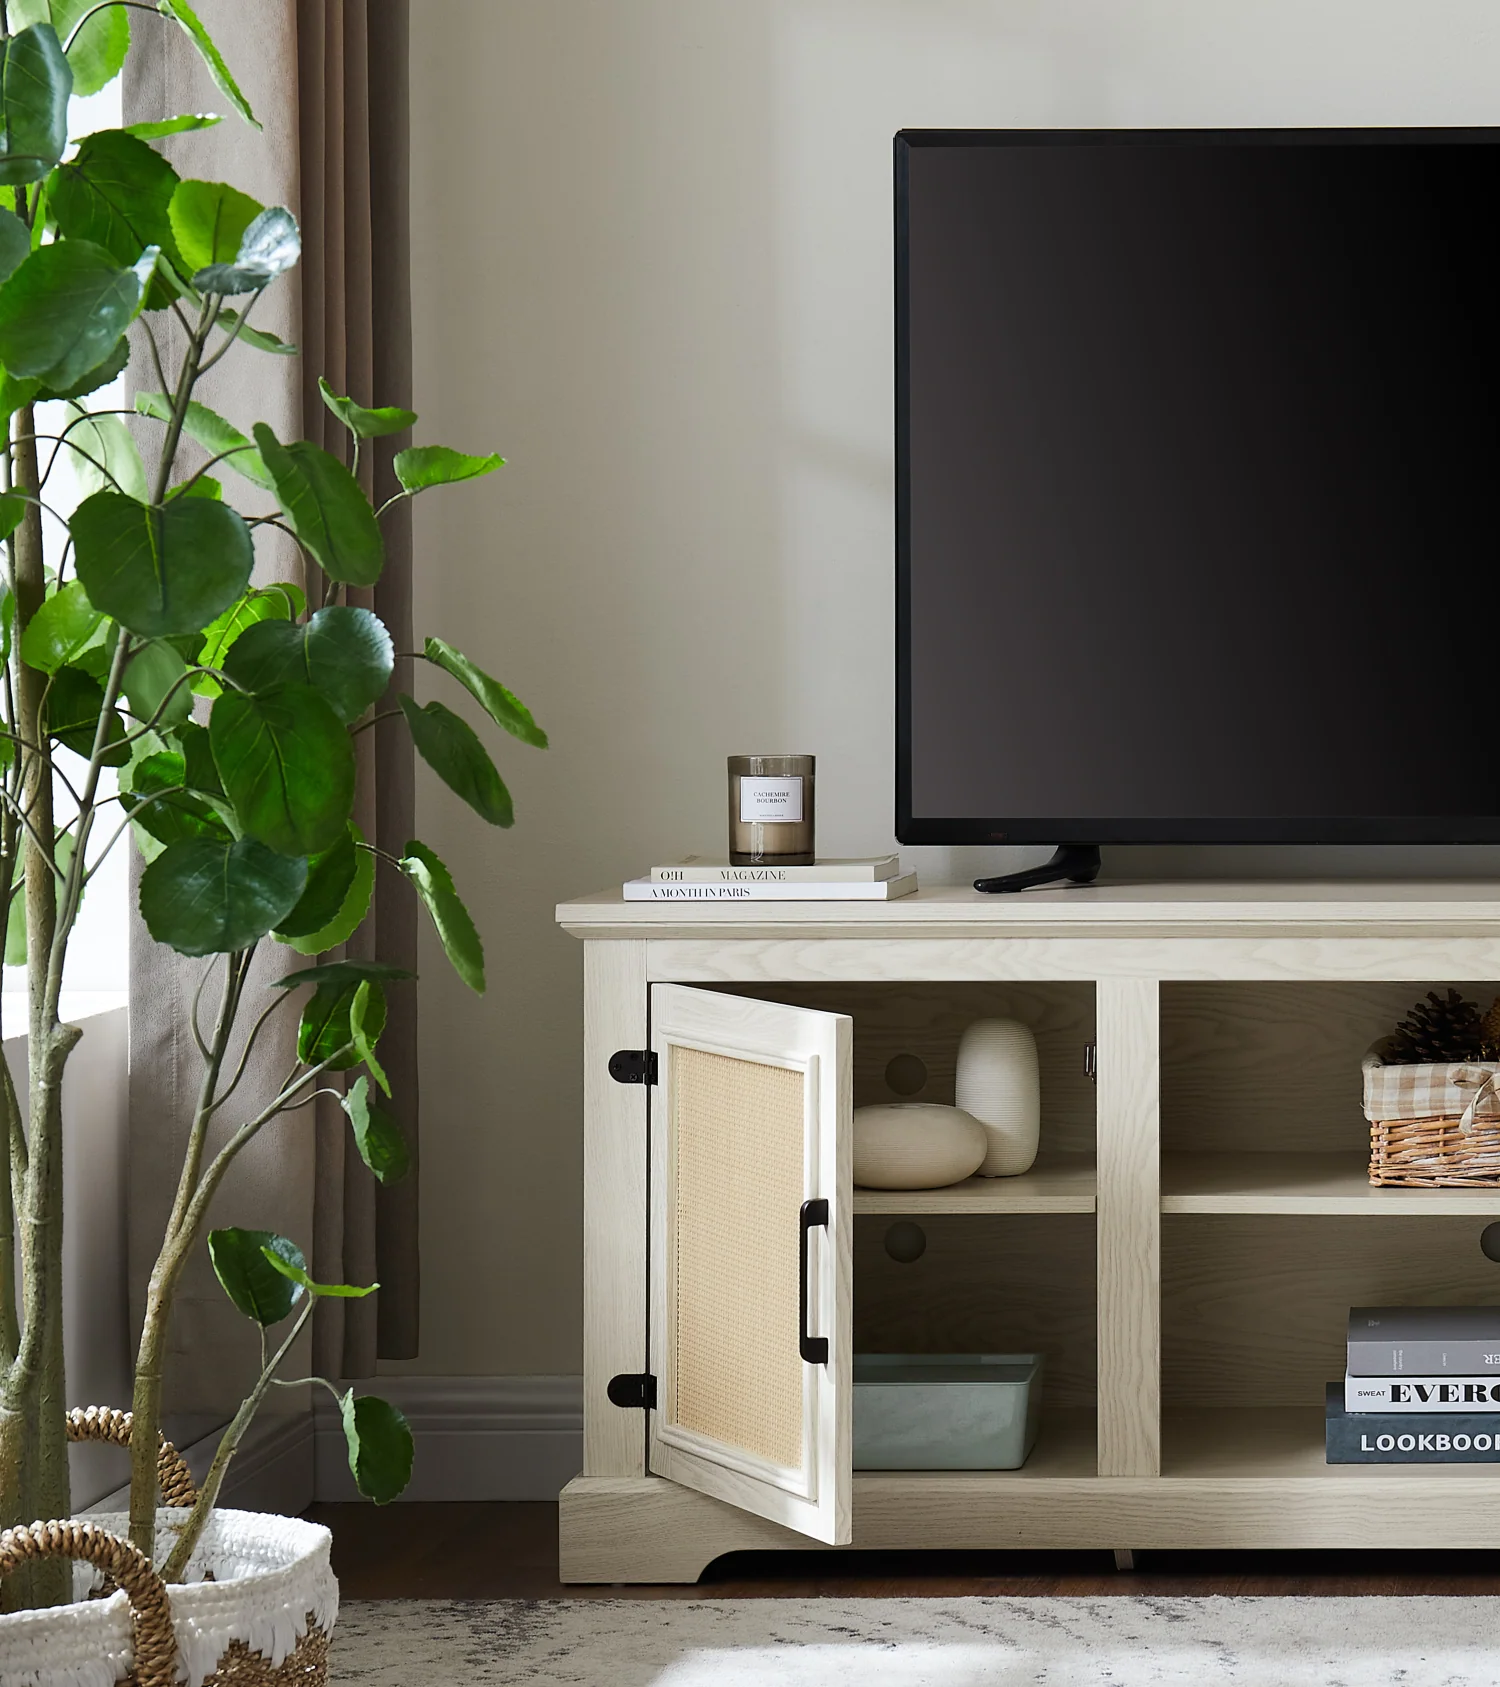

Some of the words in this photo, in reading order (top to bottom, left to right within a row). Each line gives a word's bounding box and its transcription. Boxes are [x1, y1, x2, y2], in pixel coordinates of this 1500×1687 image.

[660, 870, 683, 881] O!H
[720, 870, 786, 880] MAGAZINE
[650, 888, 658, 898] A
[660, 888, 702, 898] MONTH
[705, 888, 716, 897] IN
[719, 887, 751, 898] PARIS
